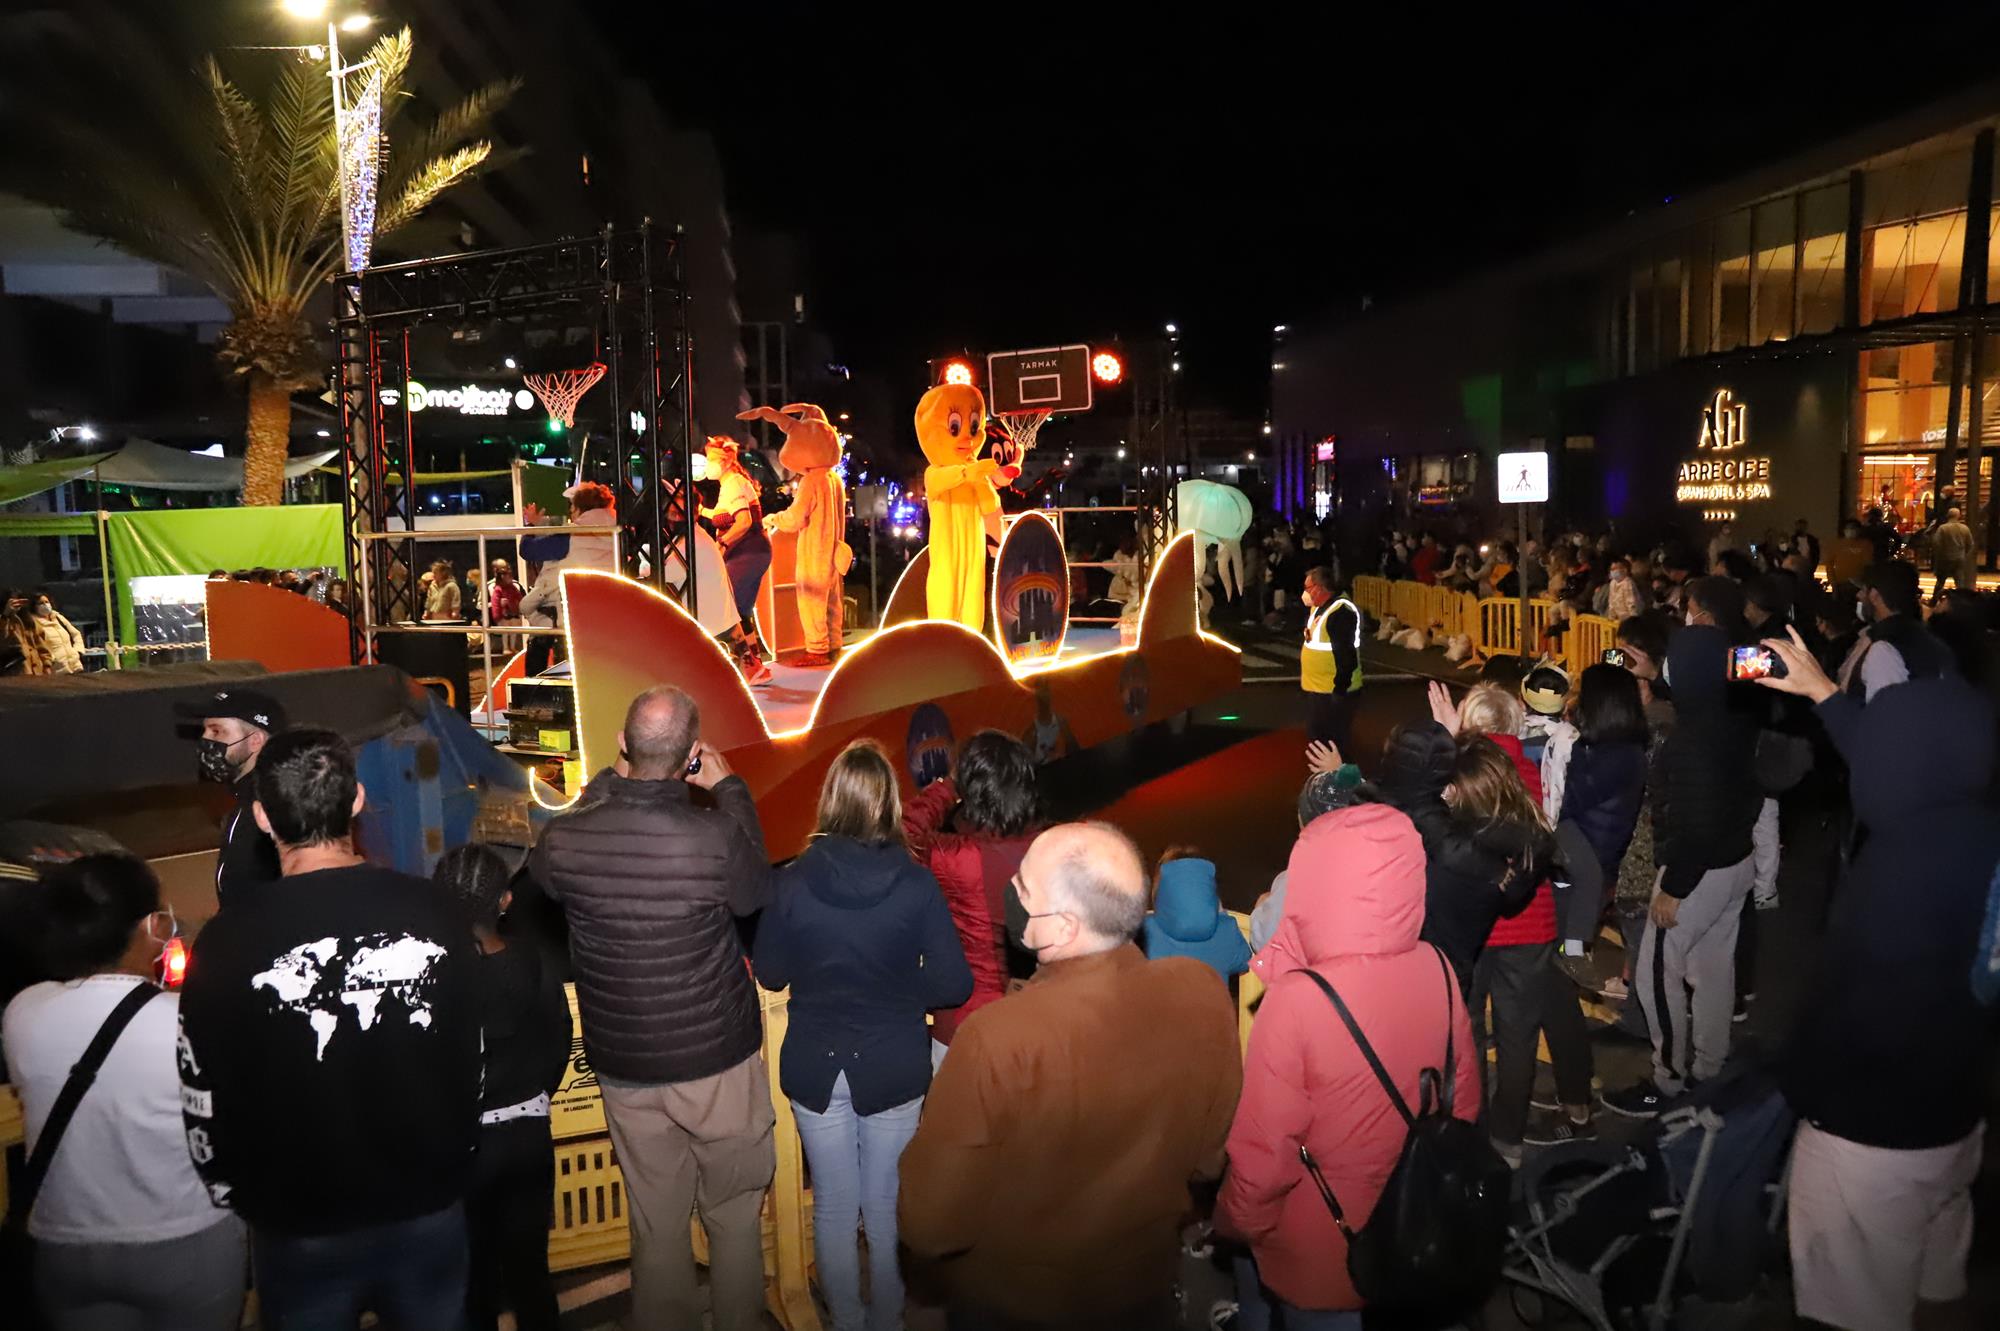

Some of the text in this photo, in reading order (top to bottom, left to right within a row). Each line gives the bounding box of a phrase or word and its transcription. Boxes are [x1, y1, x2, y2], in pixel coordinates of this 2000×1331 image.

[1020, 360, 1057, 369] TARMAK
[1679, 459, 1770, 480] ARRECIFE
[1746, 483, 1770, 499] SPA
